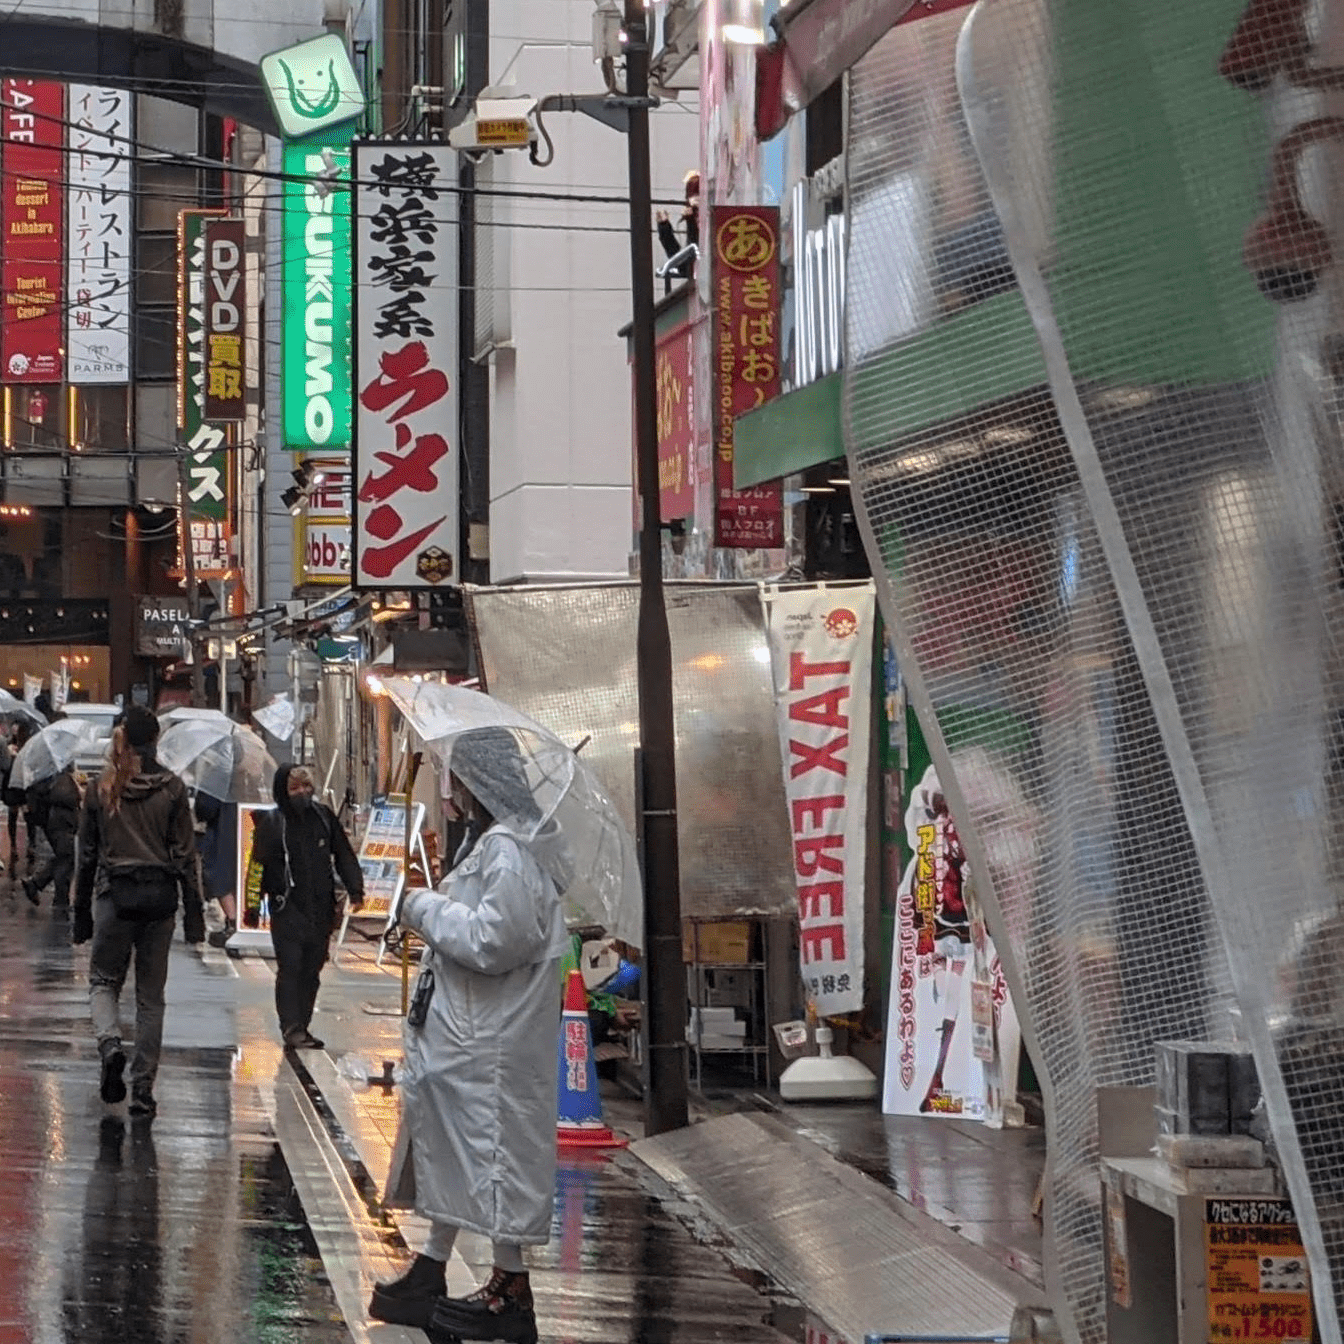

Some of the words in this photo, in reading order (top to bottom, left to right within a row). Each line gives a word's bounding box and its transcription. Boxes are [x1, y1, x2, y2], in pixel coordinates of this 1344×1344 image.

[10, 80, 34, 144] AFE
[97, 89, 124, 330] ライブレストラン
[368, 151, 442, 340] 横浜家系
[208, 239, 243, 400] DVD買取
[359, 340, 450, 578] ラーメン
